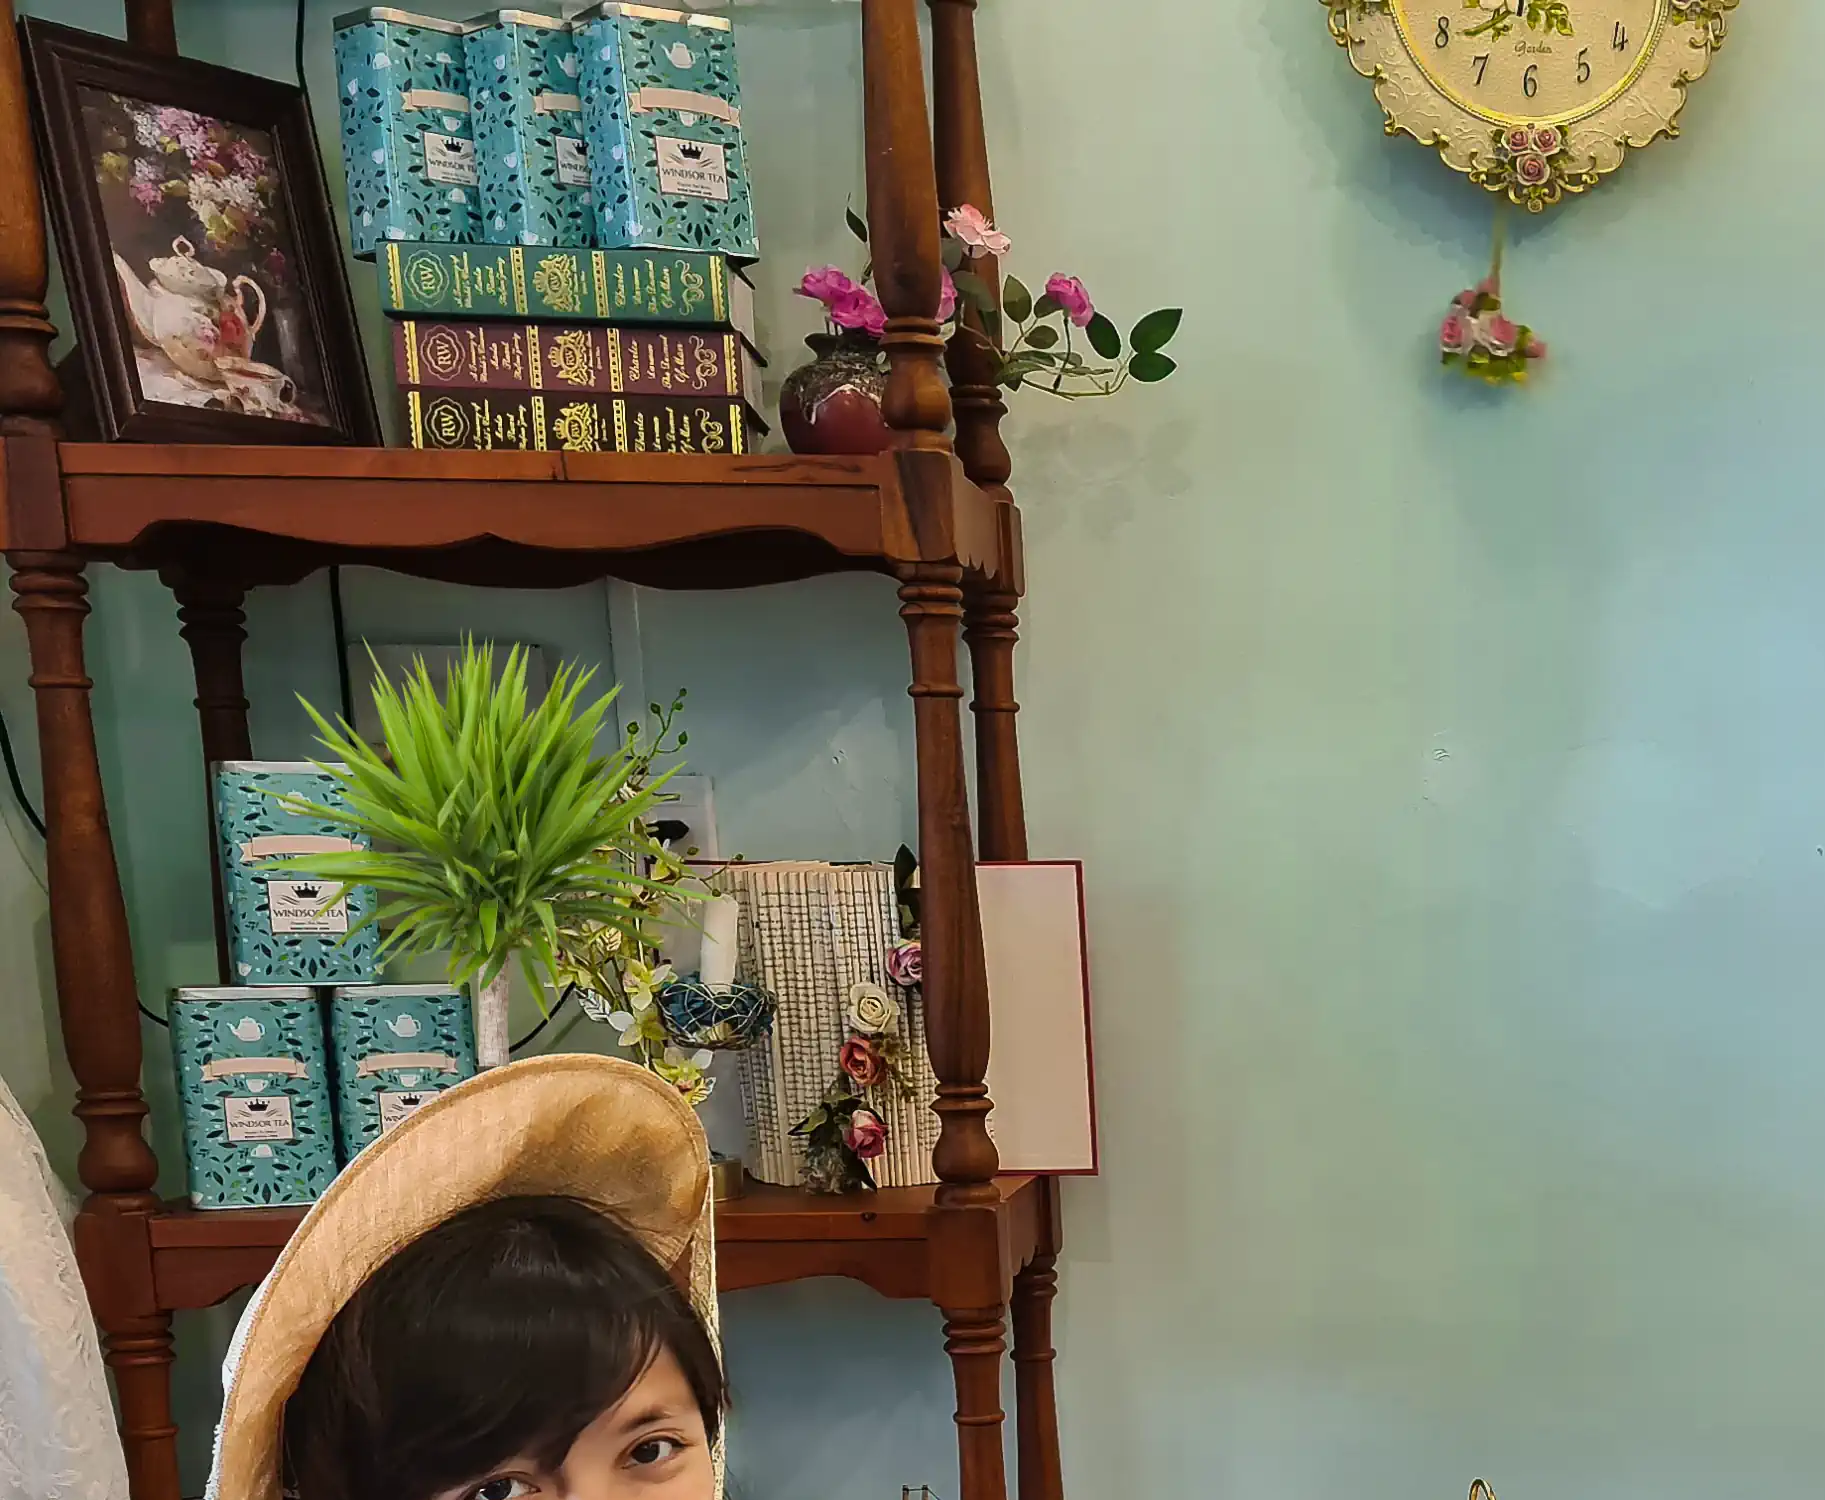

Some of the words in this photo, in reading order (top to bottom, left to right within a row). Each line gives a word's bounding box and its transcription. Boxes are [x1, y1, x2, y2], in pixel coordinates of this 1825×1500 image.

[1435, 16, 1449, 49] 8
[1612, 21, 1628, 51] 4
[1471, 53, 1490, 86] 7
[1577, 47, 1590, 84] 5
[1523, 64, 1538, 97] 6
[428, 158, 465, 171] WINDSOR
[662, 167, 706, 181] WINDSOR
[707, 172, 725, 184] TEA
[419, 264, 434, 291] RW
[436, 340, 451, 366] RW
[441, 412, 456, 437] RW
[326, 908, 345, 918] TEA
[229, 1120, 272, 1129] WINDSOR
[274, 1118, 290, 1128] TEA
